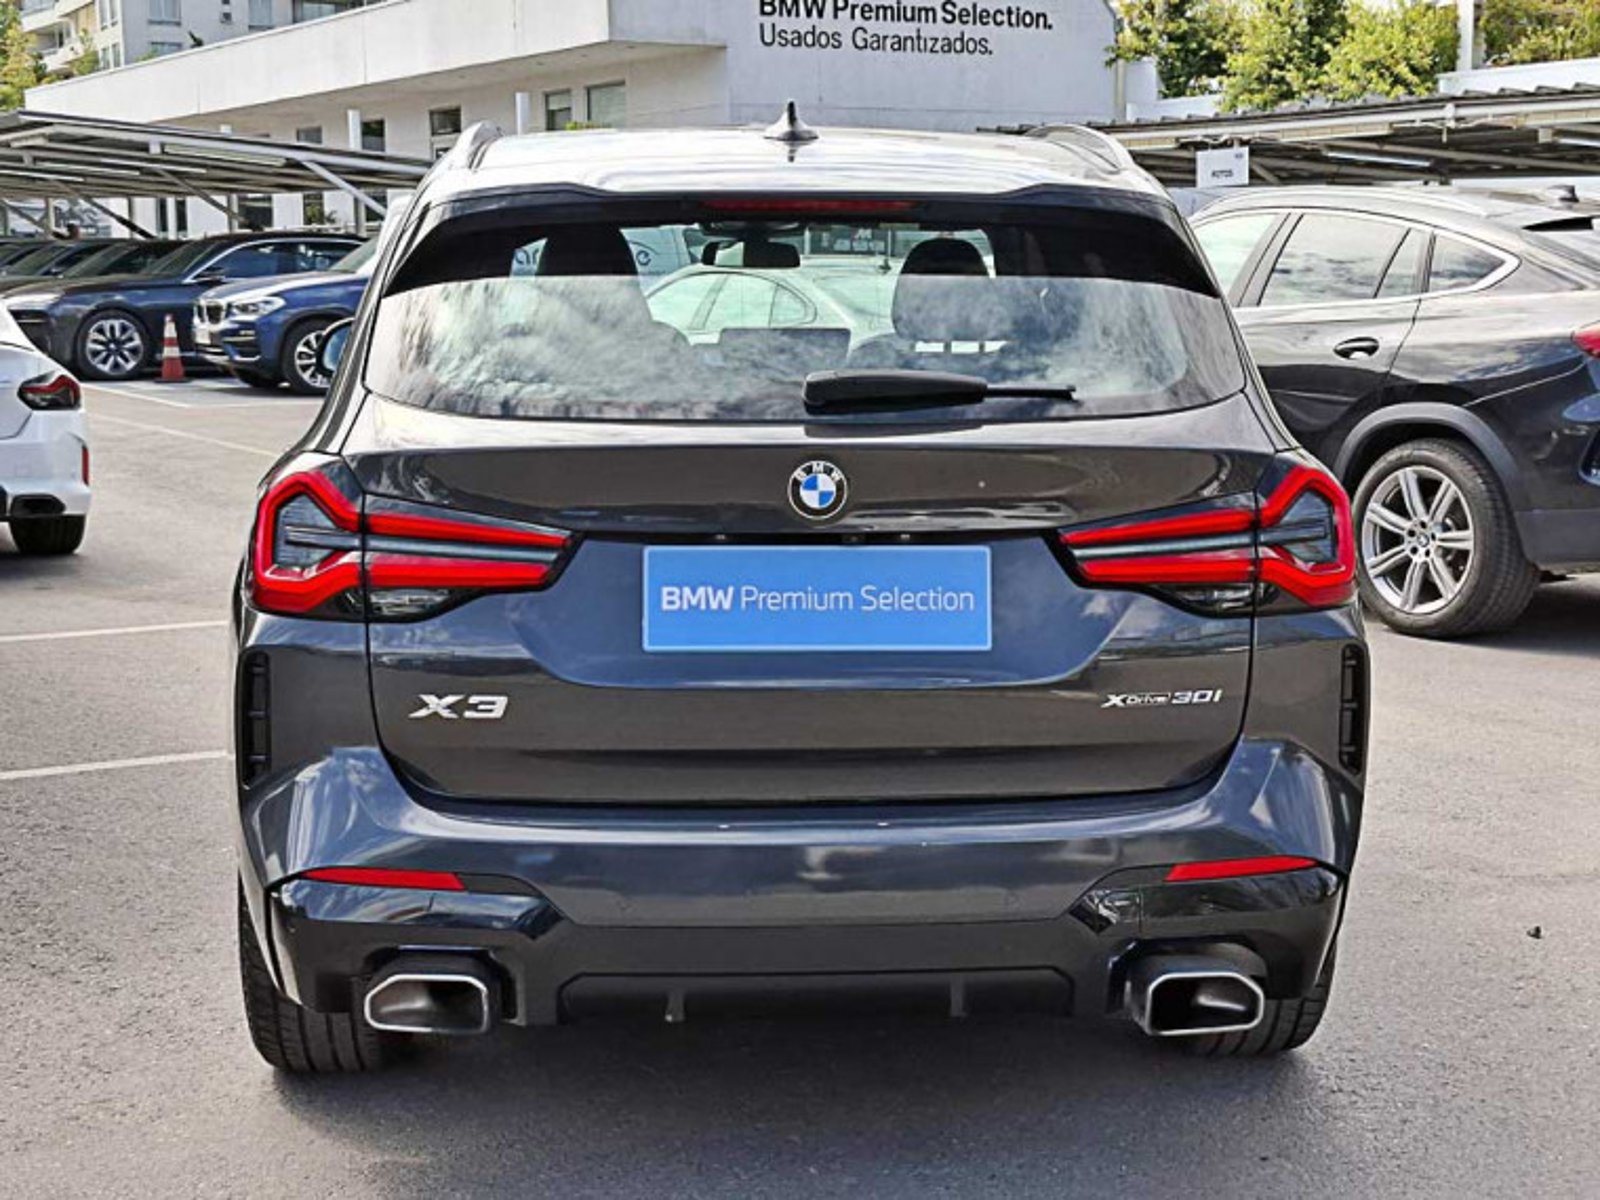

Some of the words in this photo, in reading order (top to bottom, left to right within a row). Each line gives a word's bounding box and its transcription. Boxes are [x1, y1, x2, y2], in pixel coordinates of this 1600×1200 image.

[760, 0, 827, 18] BMW
[833, 0, 939, 23] Premium
[942, 1, 1053, 29] Selection.
[760, 22, 842, 48] Usados
[852, 27, 994, 55] Garantizados.
[661, 586, 734, 611] BMW
[740, 586, 853, 611] Premium
[861, 584, 975, 611] Selection
[408, 694, 508, 718] X3
